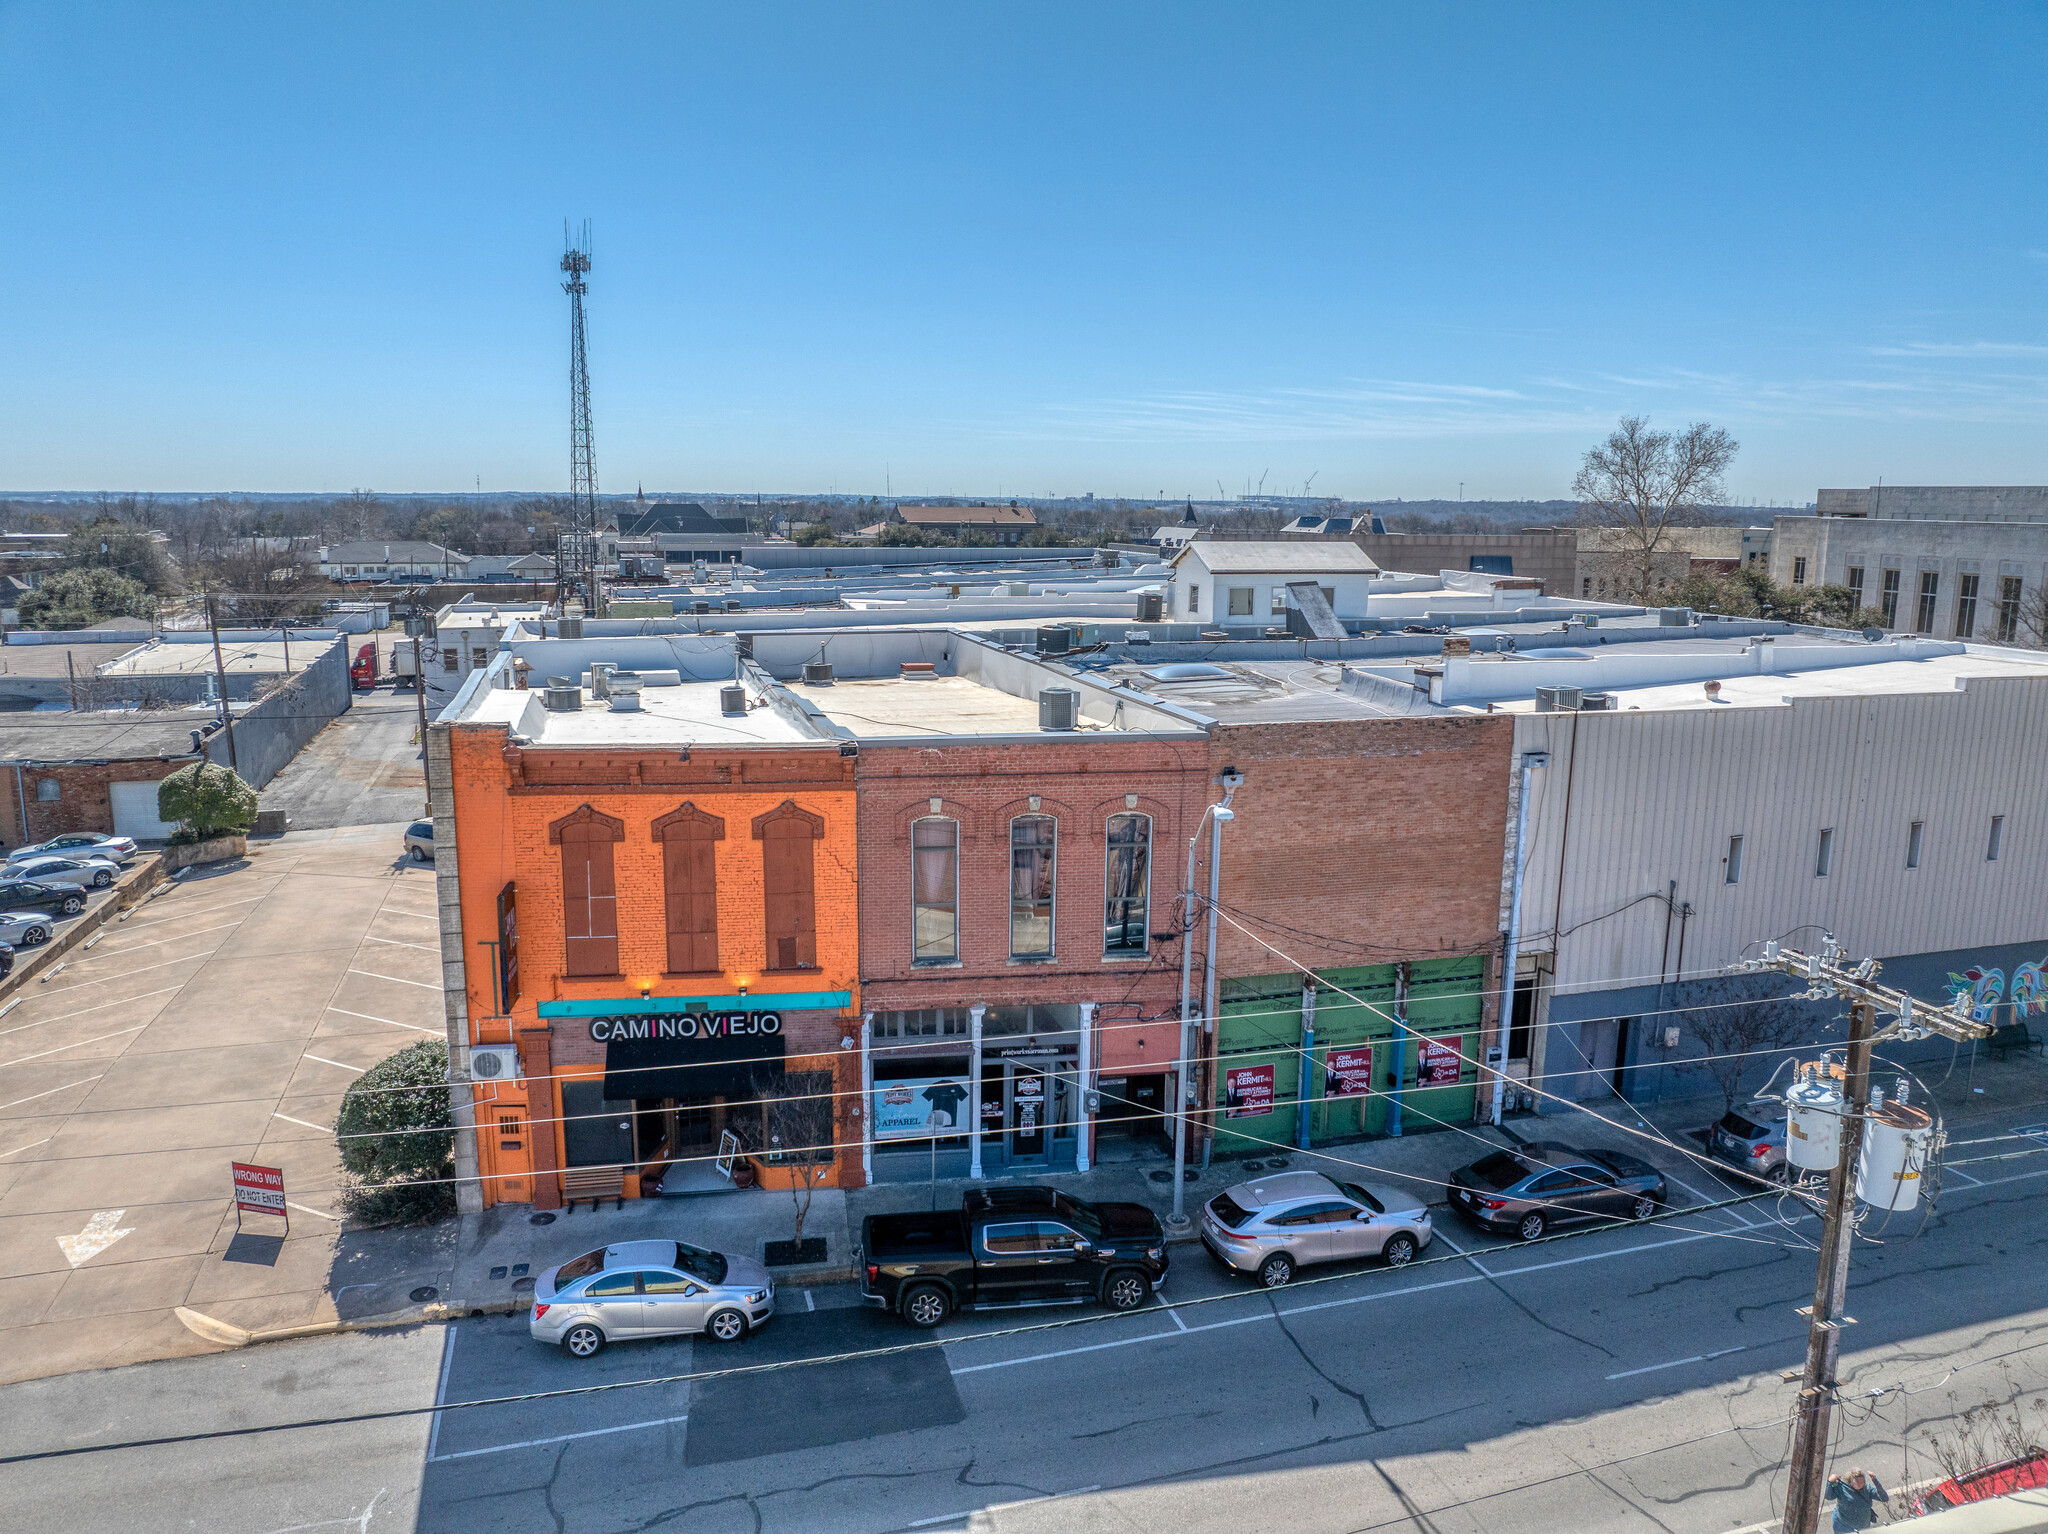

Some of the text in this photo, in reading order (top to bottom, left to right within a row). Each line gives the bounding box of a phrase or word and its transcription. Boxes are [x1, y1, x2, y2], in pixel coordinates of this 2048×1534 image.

[592, 1014, 779, 1040] CAMINO VIEJO
[1336, 1058, 1362, 1068] KERMIT
[1237, 1074, 1264, 1086] KERMIT
[882, 1117, 920, 1127] APPAREL
[233, 1169, 282, 1186] WRONG WAY
[236, 1188, 285, 1205] DO NOT ENTER
